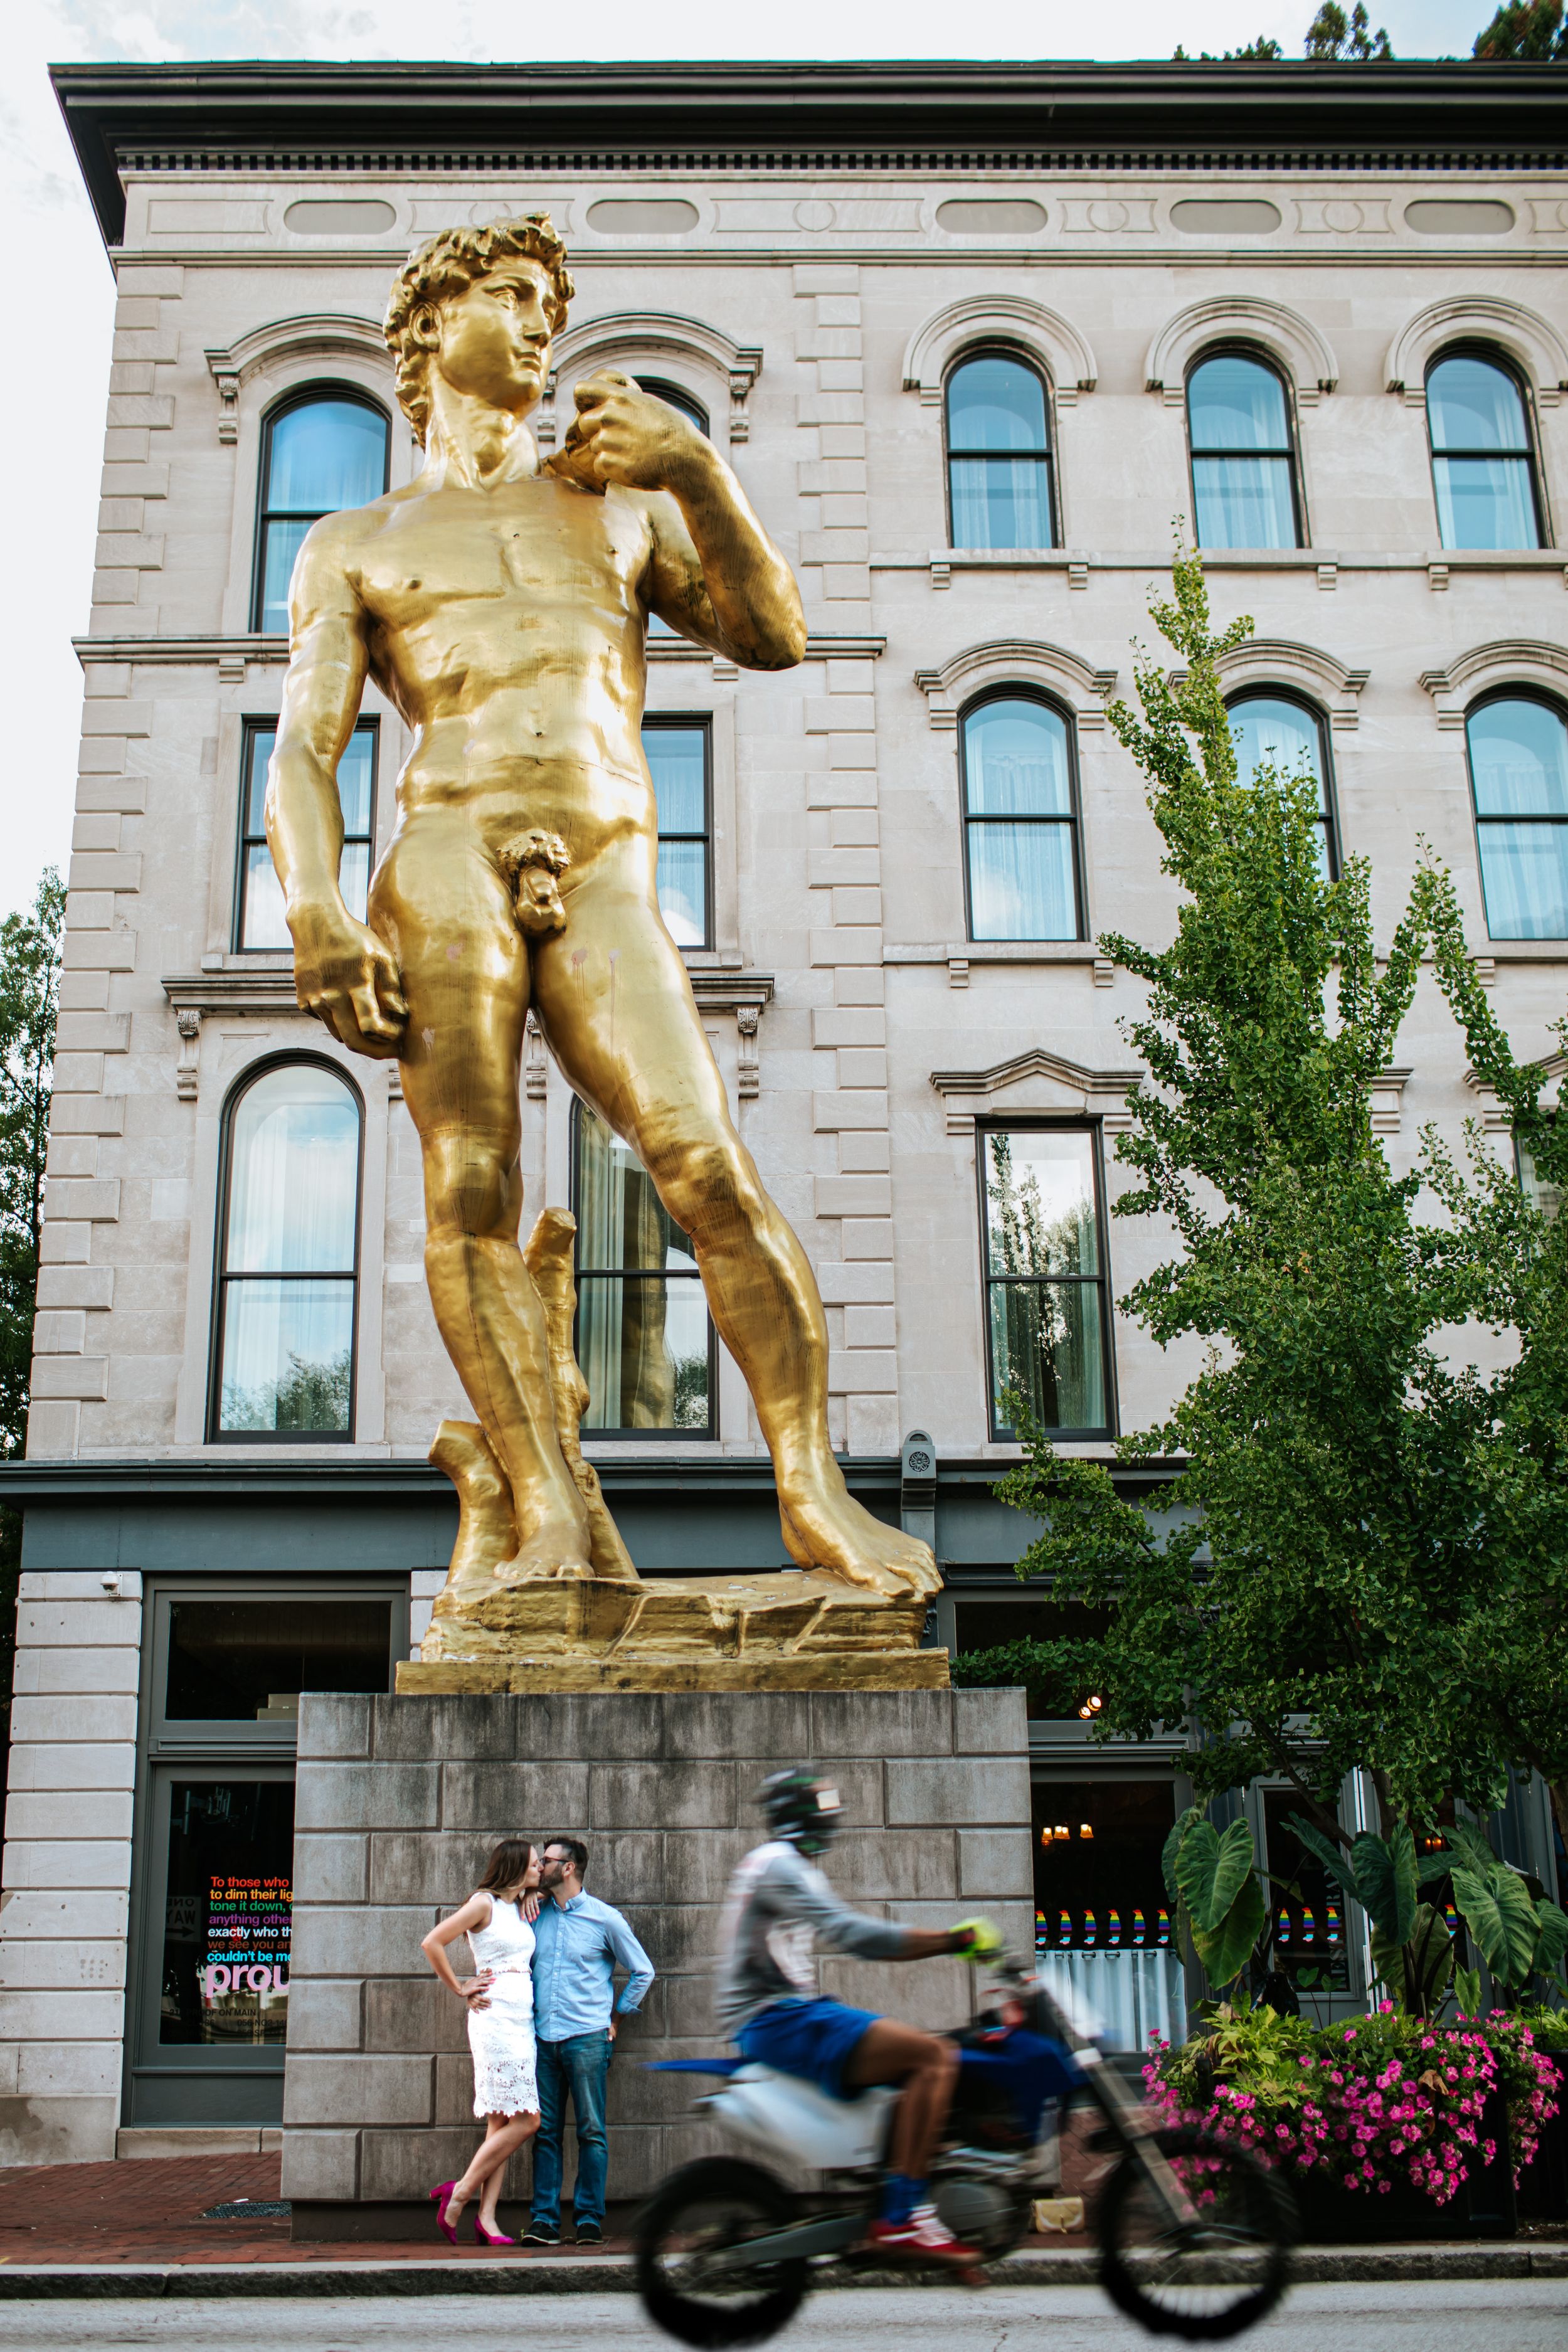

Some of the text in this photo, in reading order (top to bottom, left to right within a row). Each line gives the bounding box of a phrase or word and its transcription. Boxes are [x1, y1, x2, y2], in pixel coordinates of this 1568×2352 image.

[210, 1877, 289, 1887] To those who
[209, 1889, 223, 1899] to
[225, 1888, 247, 1899] dim
[250, 1888, 277, 1899] their
[209, 1901, 236, 1911] tone
[240, 1901, 247, 1911] it
[250, 1900, 286, 1913] down,
[209, 1914, 260, 1927] anything
[208, 1926, 251, 1939] exactly
[253, 1926, 279, 1937] who
[252, 1941, 274, 1951] you
[206, 1950, 255, 1962] couldn't
[258, 1951, 273, 1962] be
